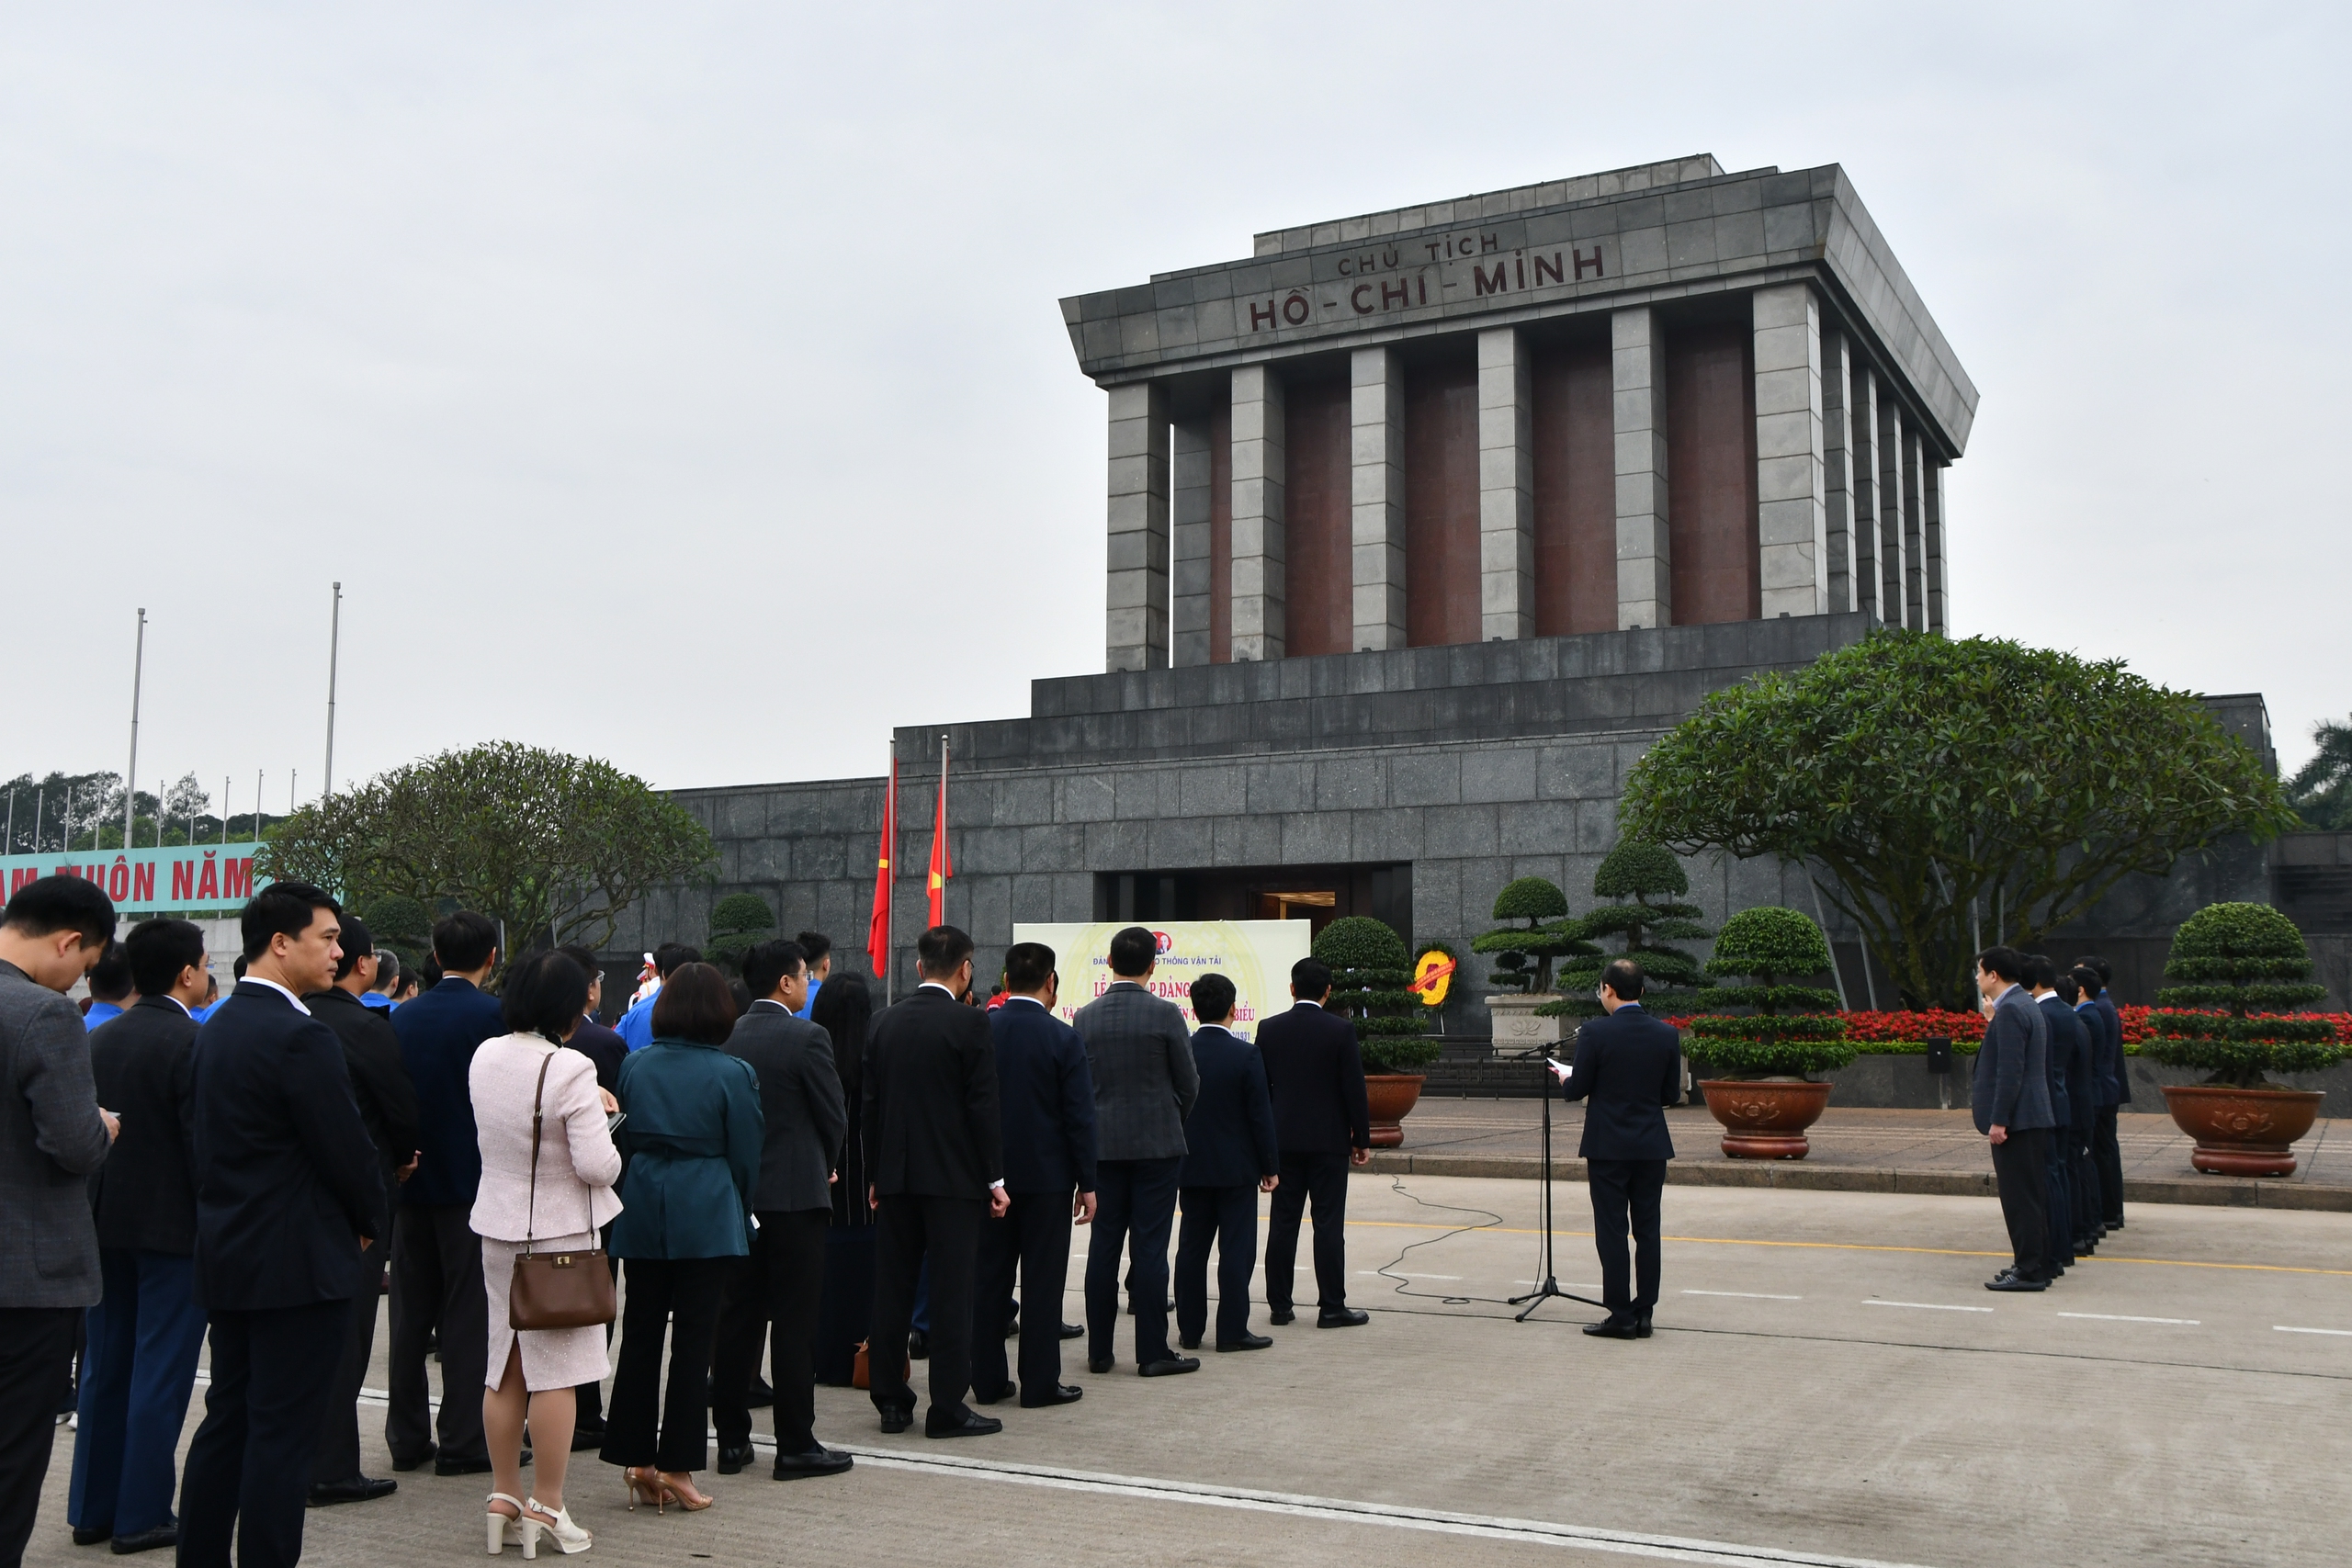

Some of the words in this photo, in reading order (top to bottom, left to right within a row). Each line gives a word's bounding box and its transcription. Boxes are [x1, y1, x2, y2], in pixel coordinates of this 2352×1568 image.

[1338, 243, 1399, 276] CHỦ
[1425, 233, 1498, 266] TỊCH
[1250, 287, 1310, 332] HỒ
[1351, 266, 1429, 314] CHÍ
[172, 851, 254, 901] NĂM
[1161, 956, 1189, 965] THÔNG
[1191, 956, 1207, 966] VẬN
[1209, 955, 1222, 964] TẢI
[1159, 975, 1191, 998] ĐẢNG
[1062, 1003, 1075, 1020] VÀ
